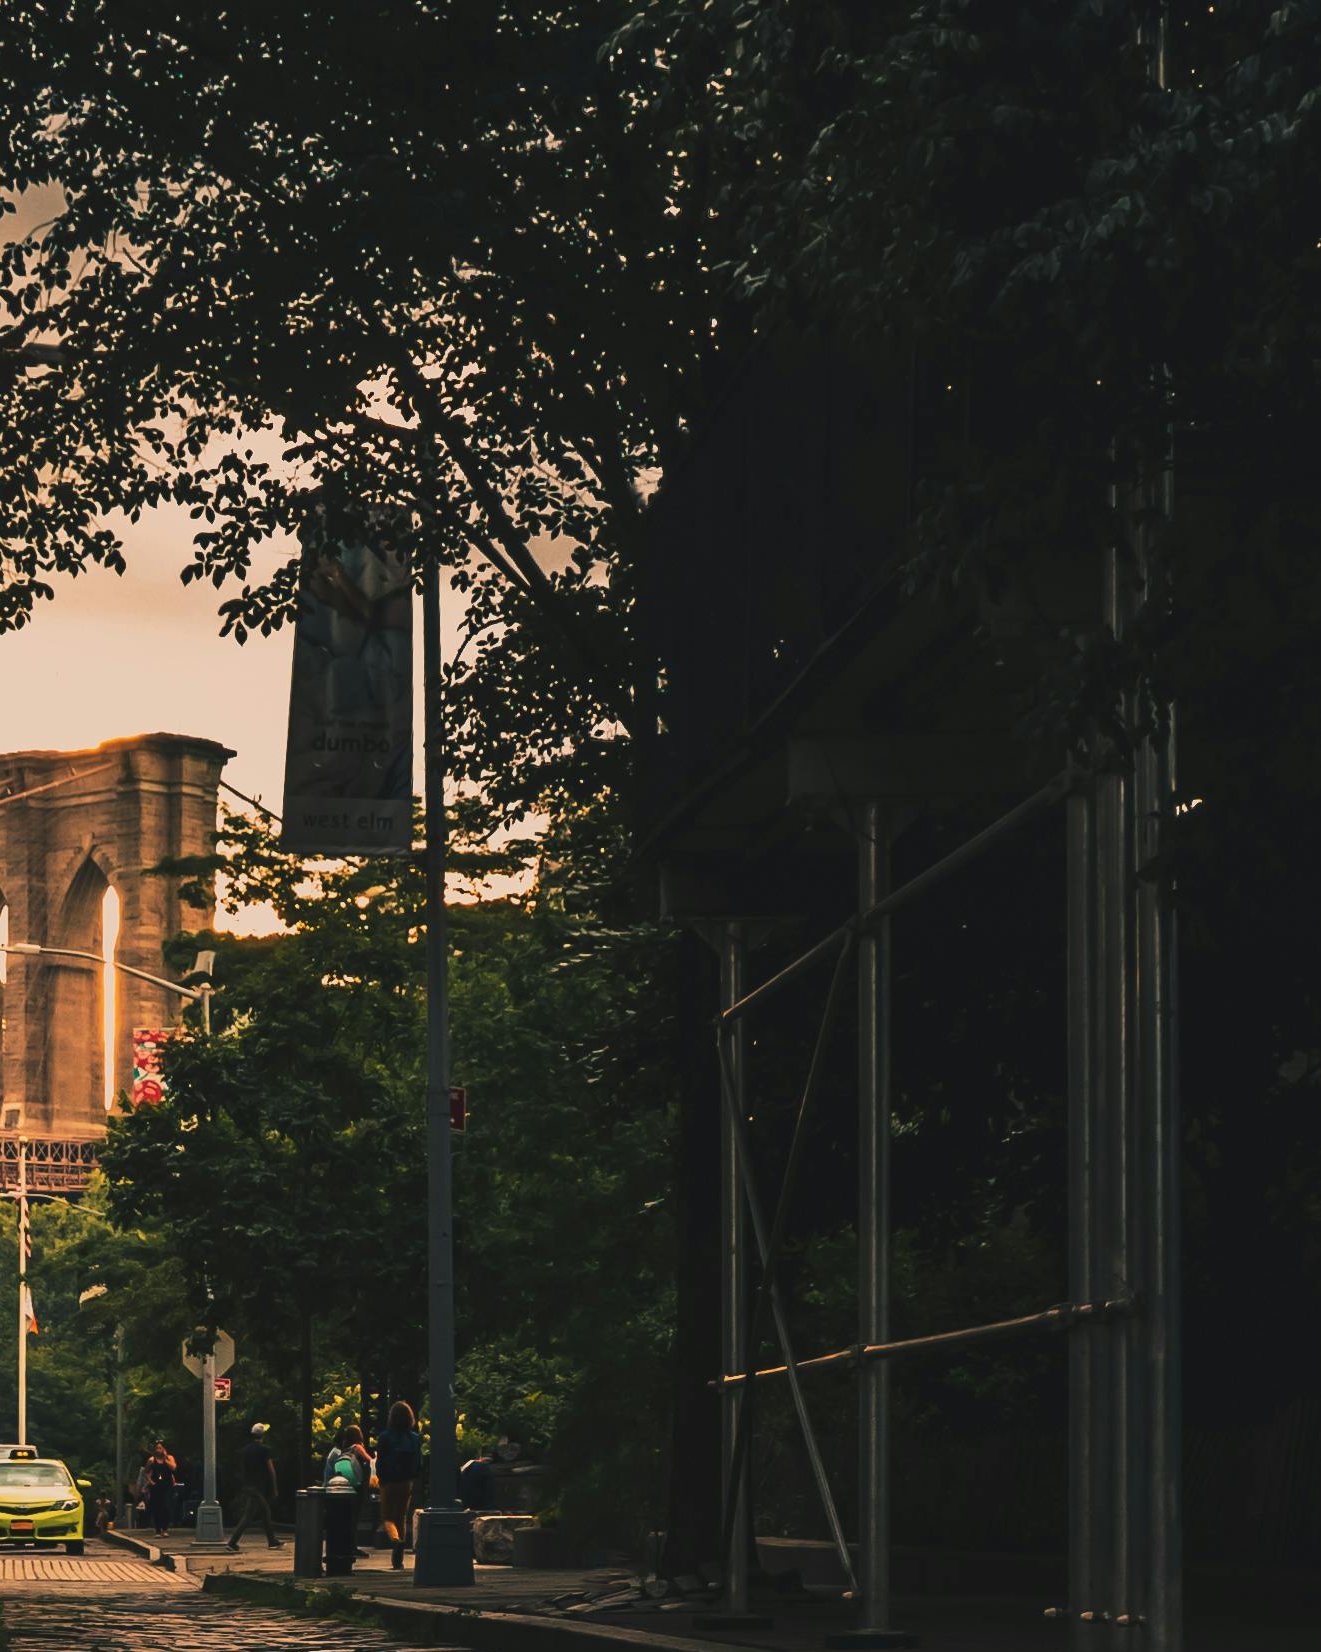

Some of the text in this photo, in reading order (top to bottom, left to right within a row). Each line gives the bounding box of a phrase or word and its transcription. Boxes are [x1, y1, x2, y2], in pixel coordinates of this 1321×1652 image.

[311, 731, 390, 752] dumbo
[303, 812, 392, 831] west elm
